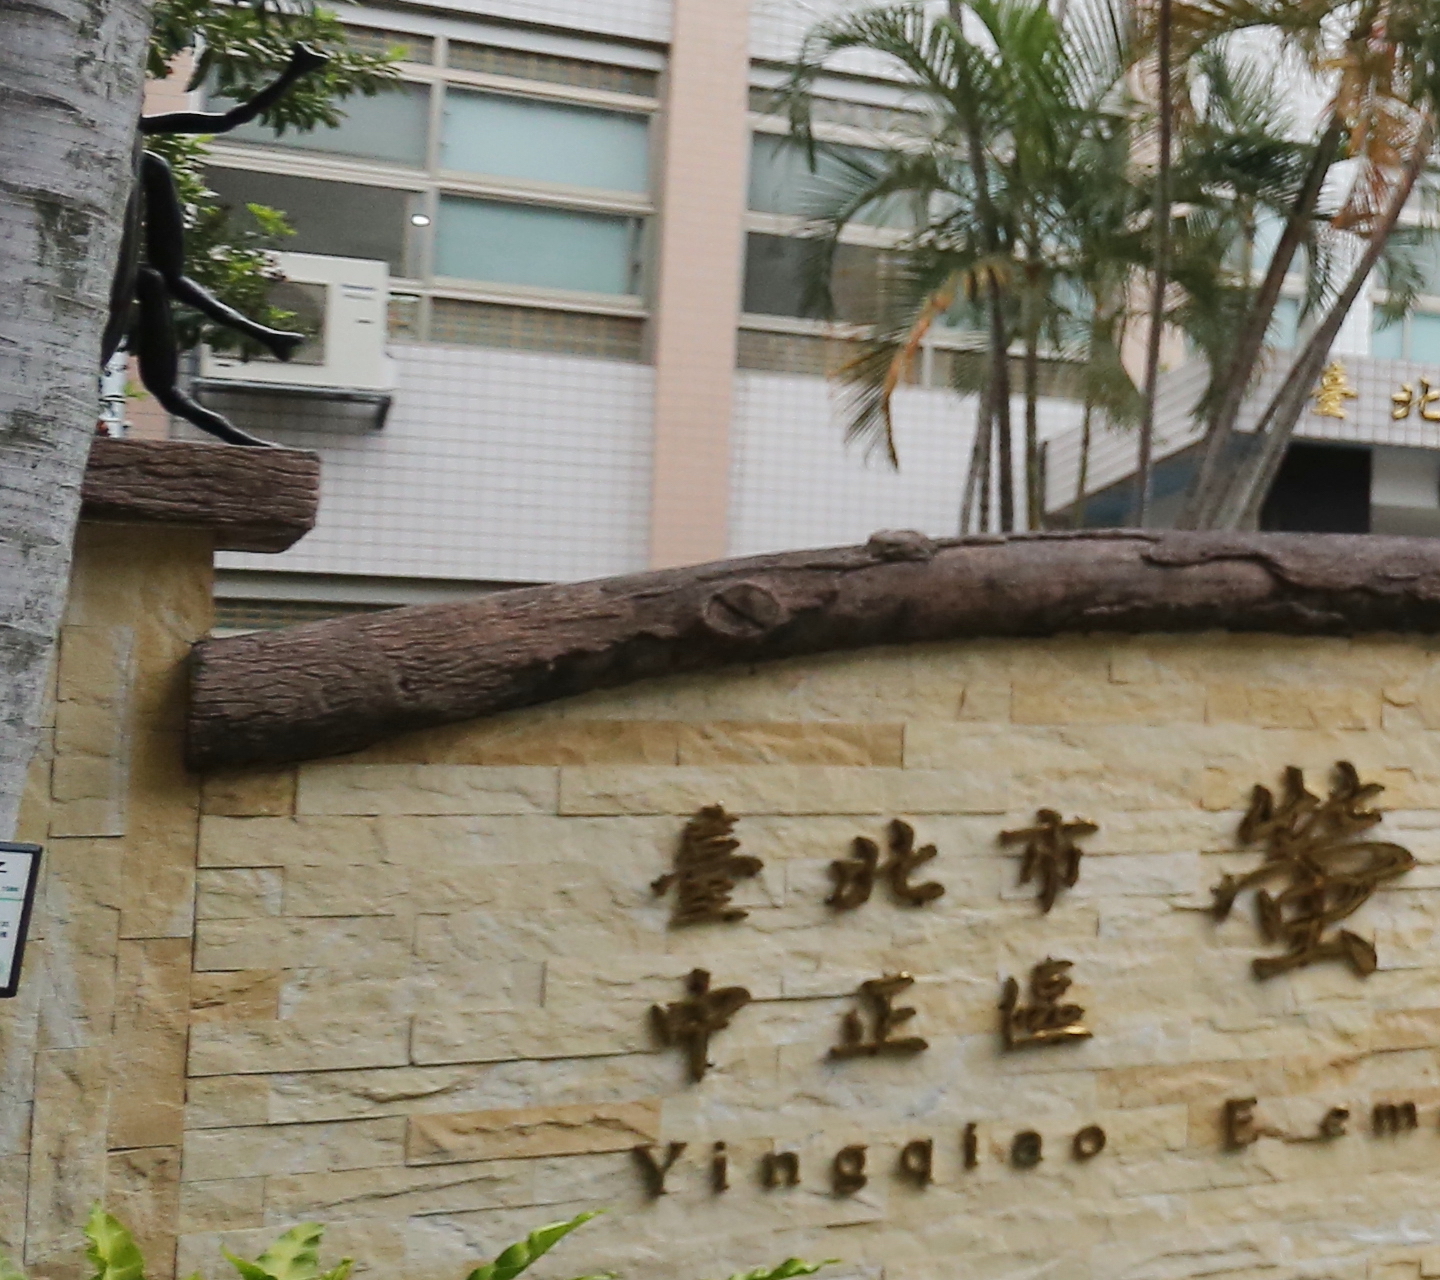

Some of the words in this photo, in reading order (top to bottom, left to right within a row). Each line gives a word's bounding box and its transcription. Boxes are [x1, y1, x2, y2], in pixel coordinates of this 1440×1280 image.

[651, 803, 1099, 926] 臺北市
[648, 958, 1094, 1083] 中正區
[633, 1123, 1107, 1198] Yingqiao
